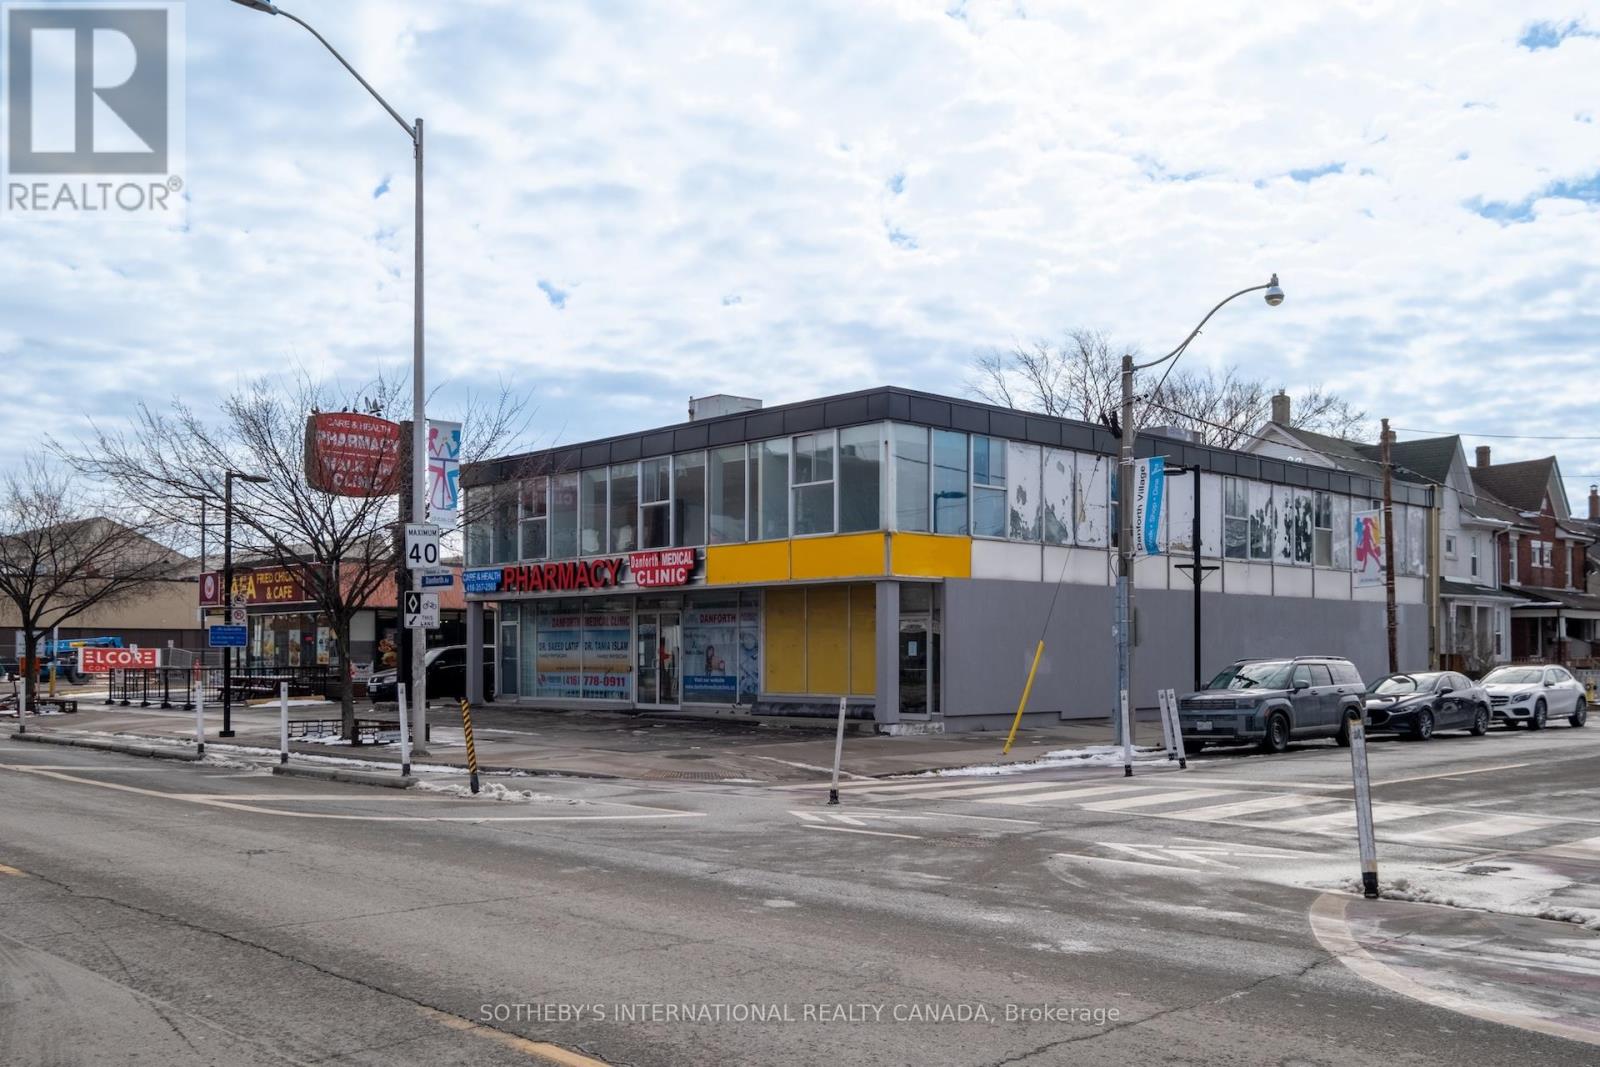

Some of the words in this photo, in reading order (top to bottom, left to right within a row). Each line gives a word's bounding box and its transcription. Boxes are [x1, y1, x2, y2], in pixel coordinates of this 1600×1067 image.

[1137, 465, 1147, 502] Village
[1136, 504, 1144, 551] Danforth
[409, 543, 437, 563] 40
[631, 553, 659, 568] Danforth
[661, 550, 693, 566] MEDICAL
[256, 573, 274, 584] FRIED
[503, 558, 622, 592] PHARMACY
[636, 567, 686, 585] CLINIC
[266, 586, 272, 600] &
[273, 585, 293, 600] CAFE
[700, 613, 737, 624] DANFORTH
[85, 651, 153, 664] ELCORE
[583, 675, 626, 687] 778-0911
